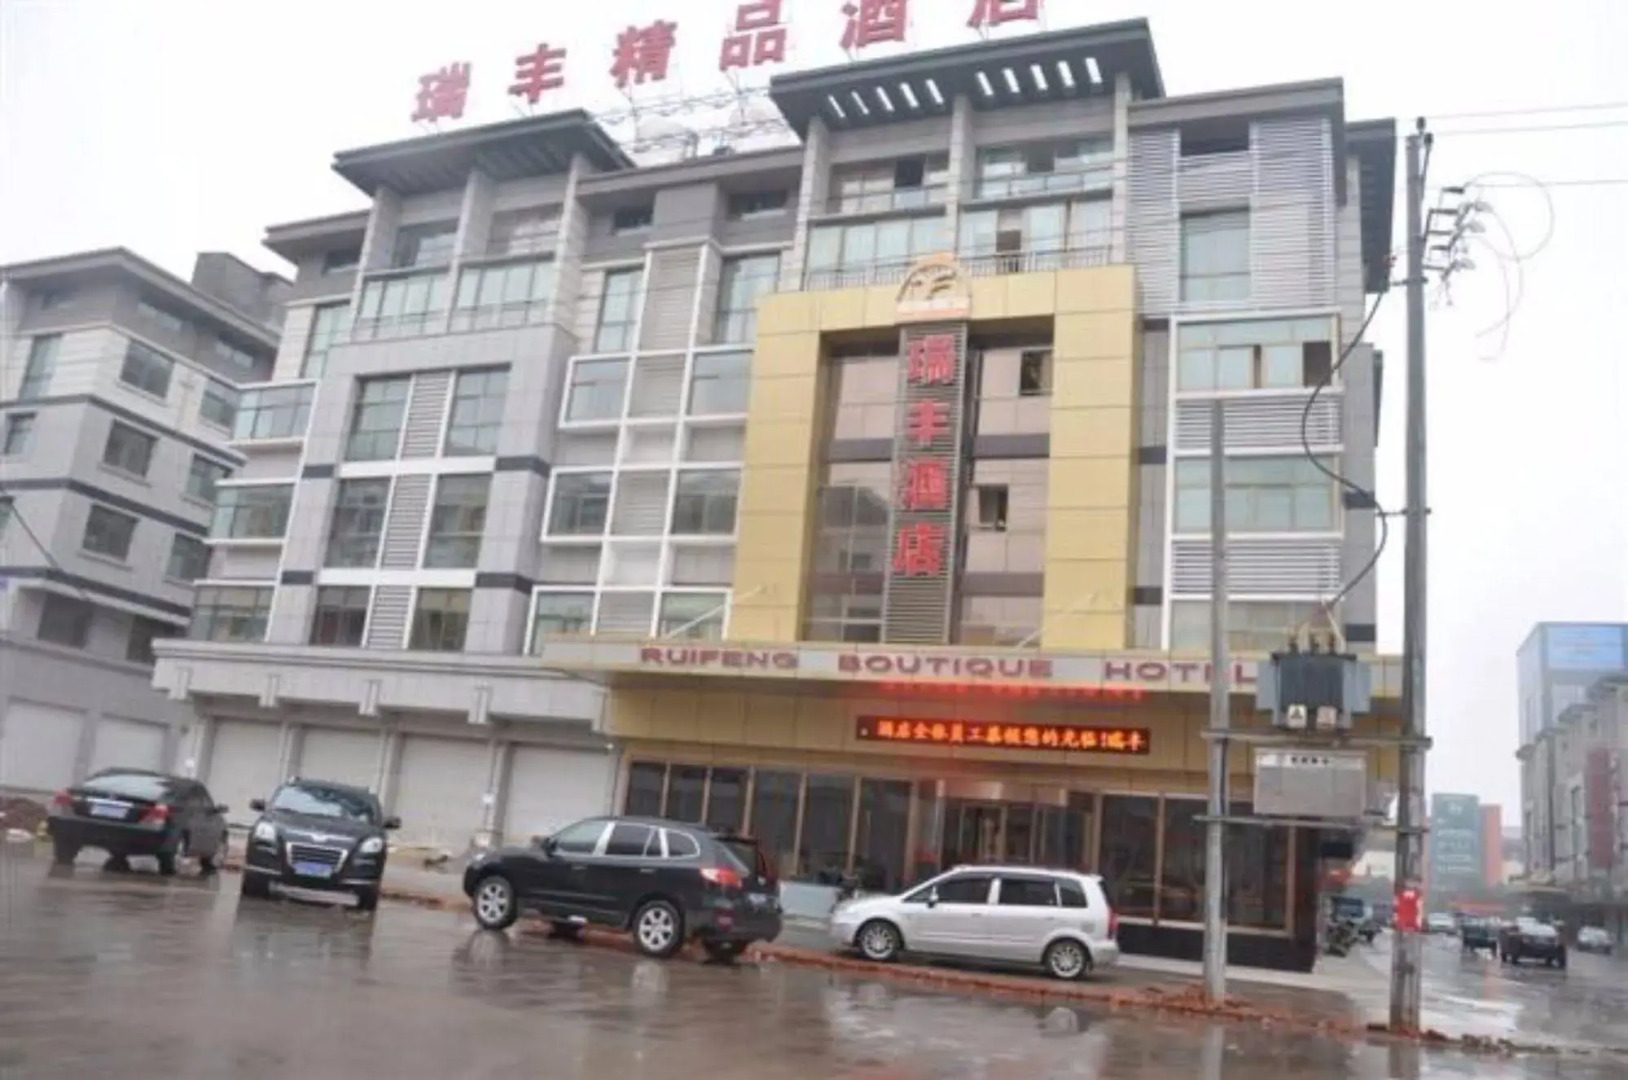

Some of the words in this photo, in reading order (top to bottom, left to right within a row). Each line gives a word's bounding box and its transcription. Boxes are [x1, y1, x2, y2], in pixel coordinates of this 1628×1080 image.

[893, 334, 956, 577] 瑞丰酒店
[640, 647, 798, 670] RUIFENG
[838, 653, 1054, 679] BOUTIQUE
[1104, 660, 1257, 685] HOTL
